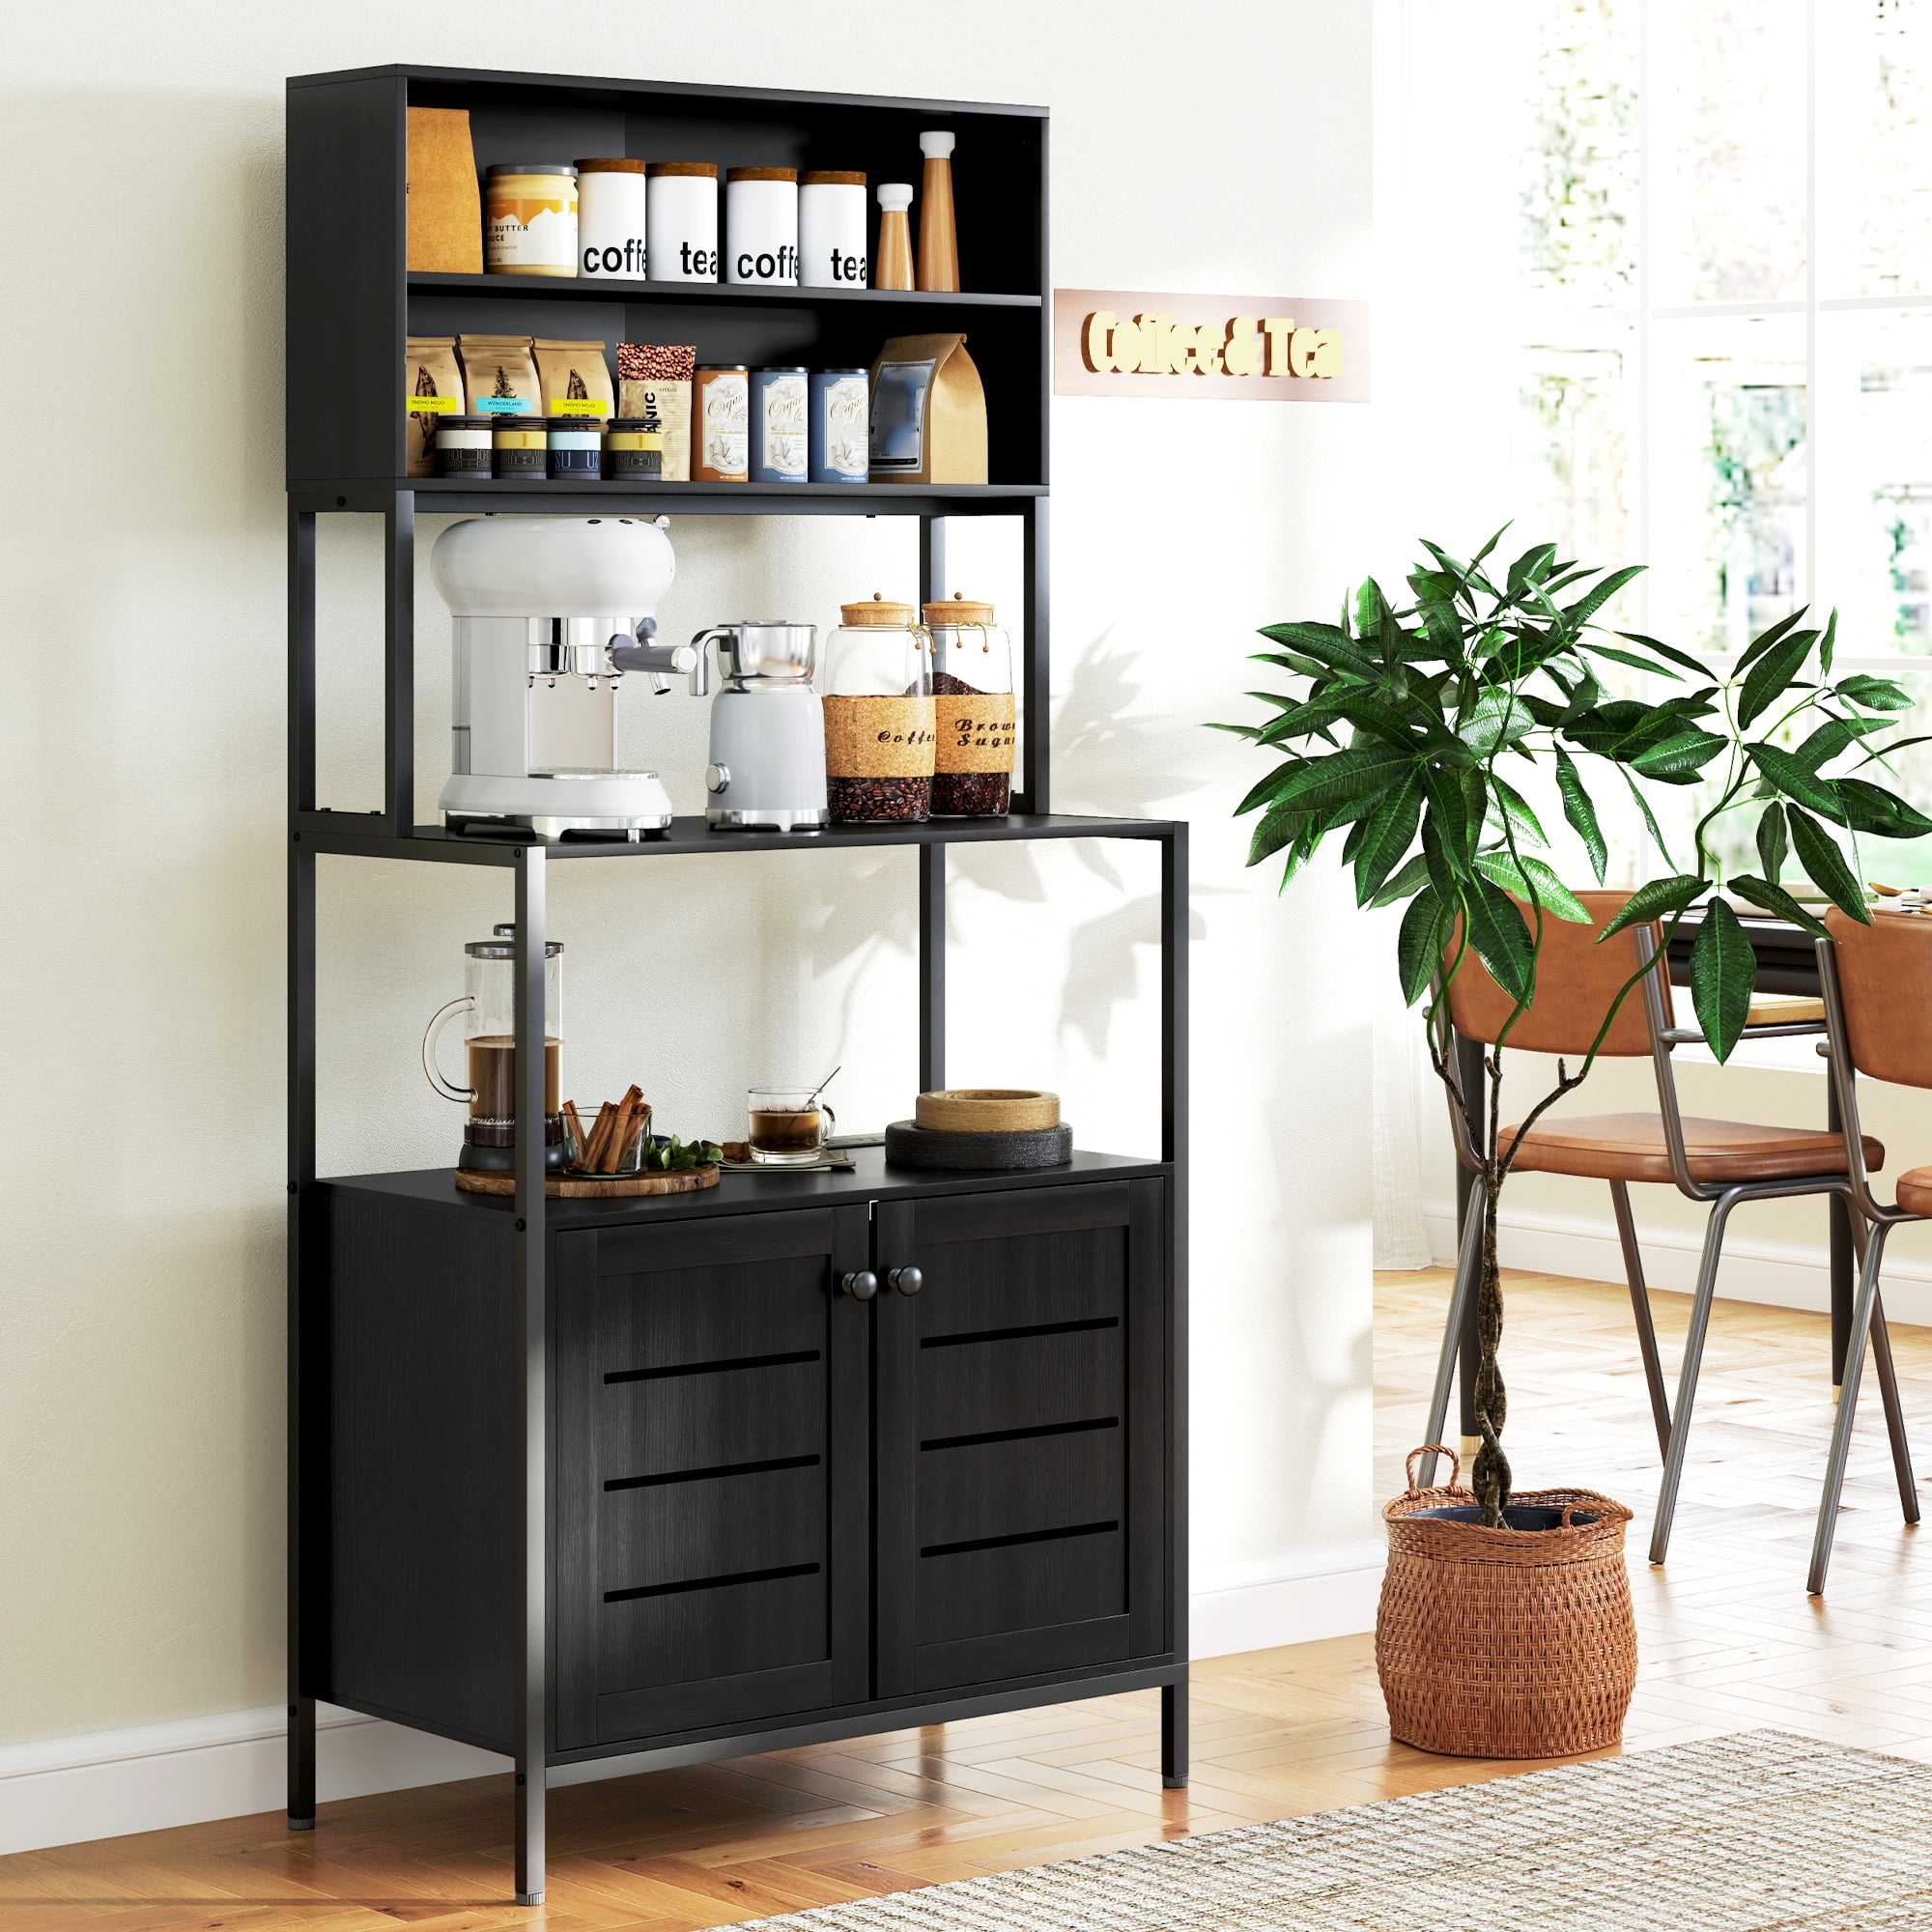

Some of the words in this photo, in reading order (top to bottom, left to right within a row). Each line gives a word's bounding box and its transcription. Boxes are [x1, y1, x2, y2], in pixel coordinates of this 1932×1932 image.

[679, 242, 717, 275] tea
[830, 248, 867, 282] tea
[1080, 310, 1225, 376] Coffee
[1222, 315, 1265, 376] &
[1257, 317, 1344, 379] Tea
